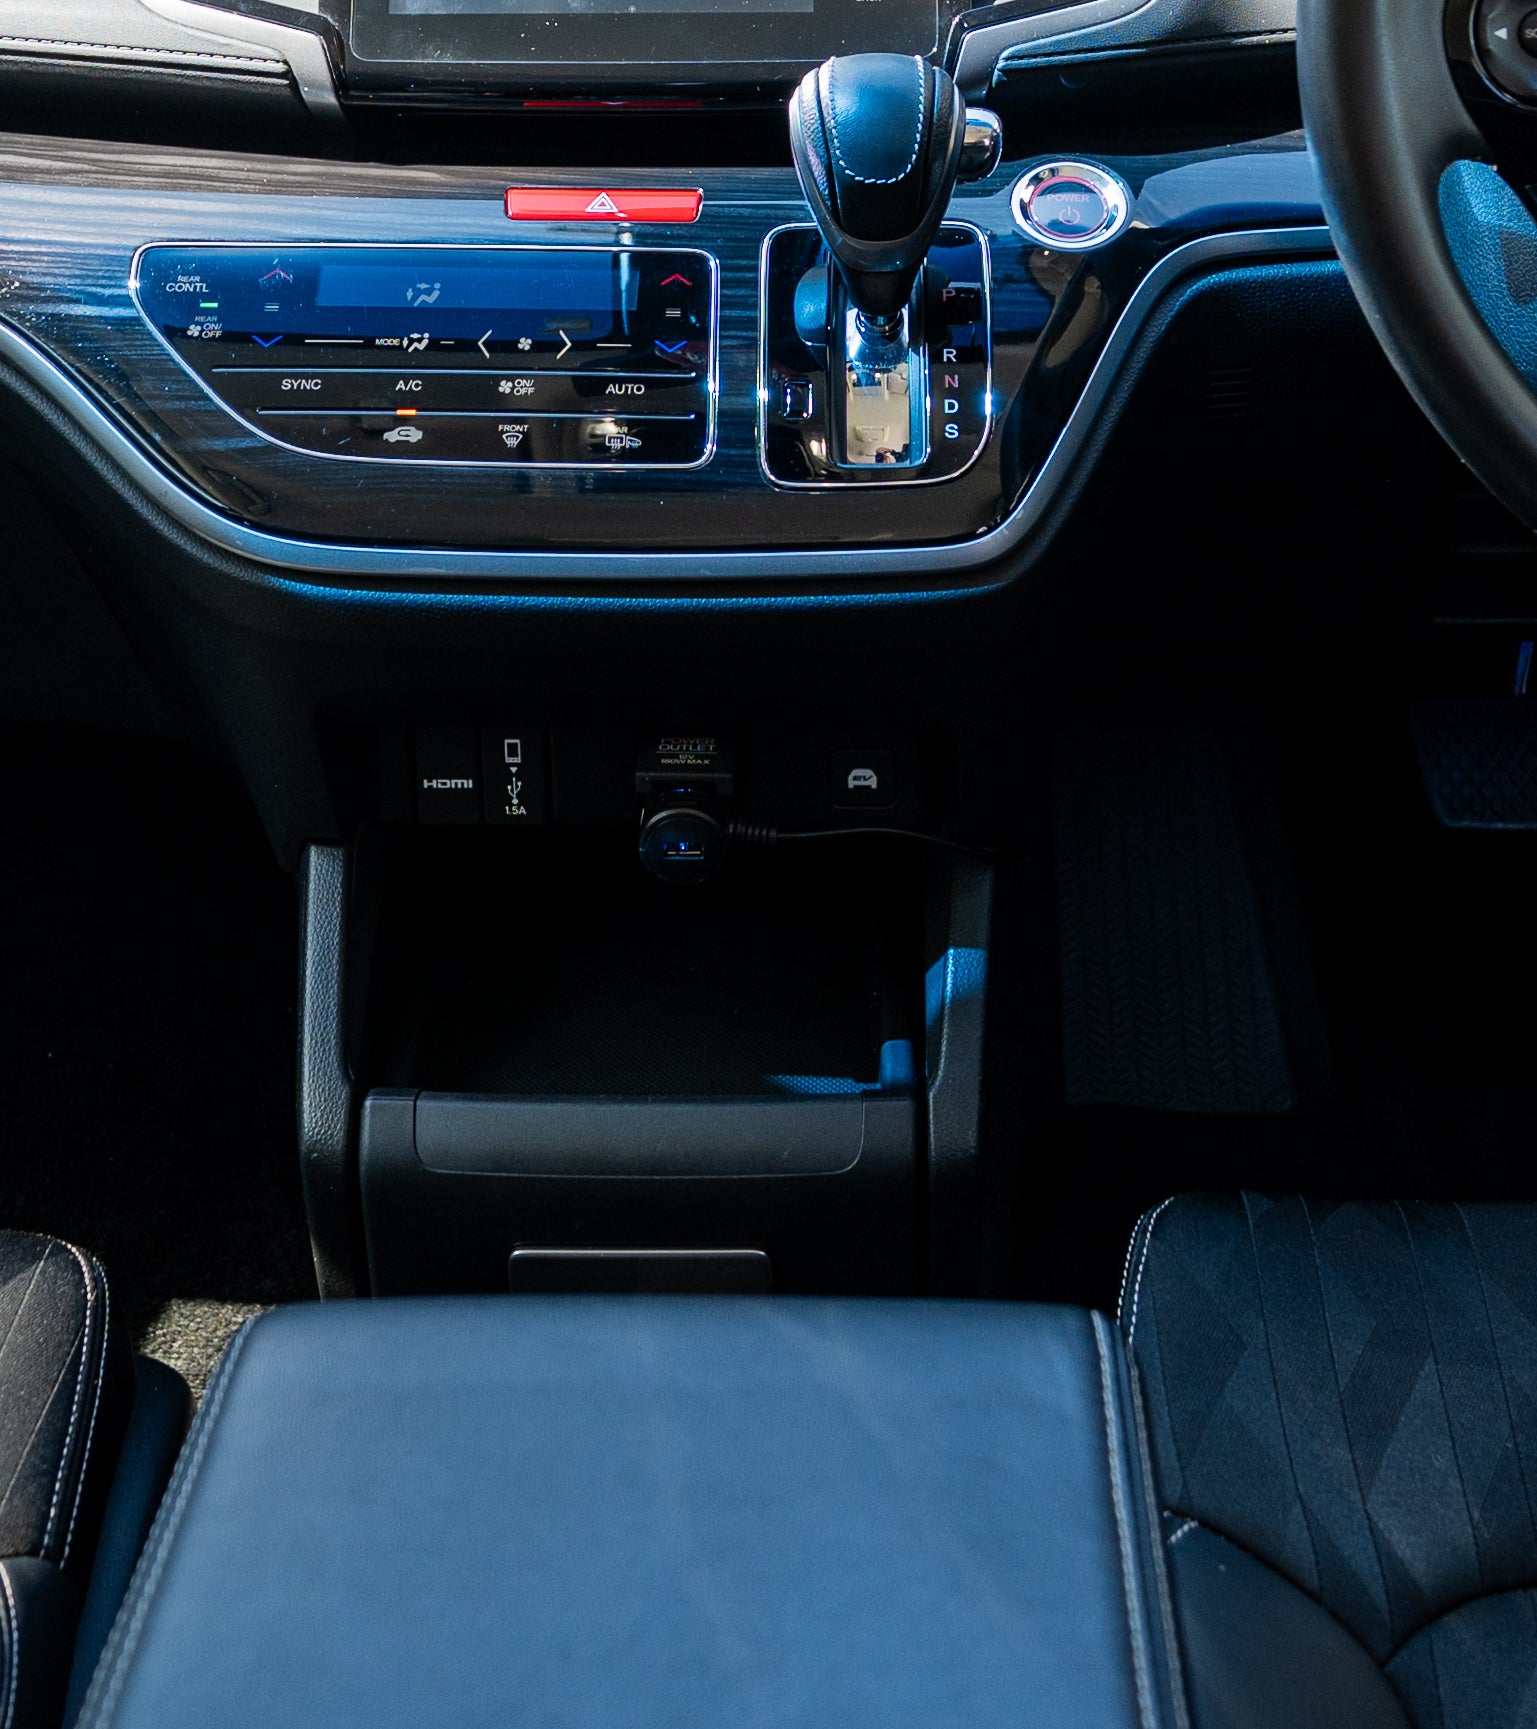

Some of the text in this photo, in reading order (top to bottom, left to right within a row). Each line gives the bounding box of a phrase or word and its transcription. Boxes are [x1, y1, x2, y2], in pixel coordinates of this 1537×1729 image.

[1045, 193, 1090, 203] POWER
[177, 274, 201, 283] REAR
[165, 282, 209, 293] CONTL
[942, 289, 956, 302] P
[203, 322, 223, 331] ON/
[201, 330, 223, 339] OFF
[375, 338, 400, 346] MODE
[943, 349, 957, 362] R
[281, 378, 322, 391] SYNC
[395, 379, 423, 391] A/C
[514, 378, 534, 388] ON/
[944, 374, 959, 388] N
[514, 387, 535, 396] OFF
[605, 383, 645, 395] AUTO
[944, 399, 959, 413] D
[498, 424, 529, 433] FRONT
[944, 424, 959, 438] S
[423, 778, 473, 789] HDMI
[505, 805, 527, 815] 1.5A
